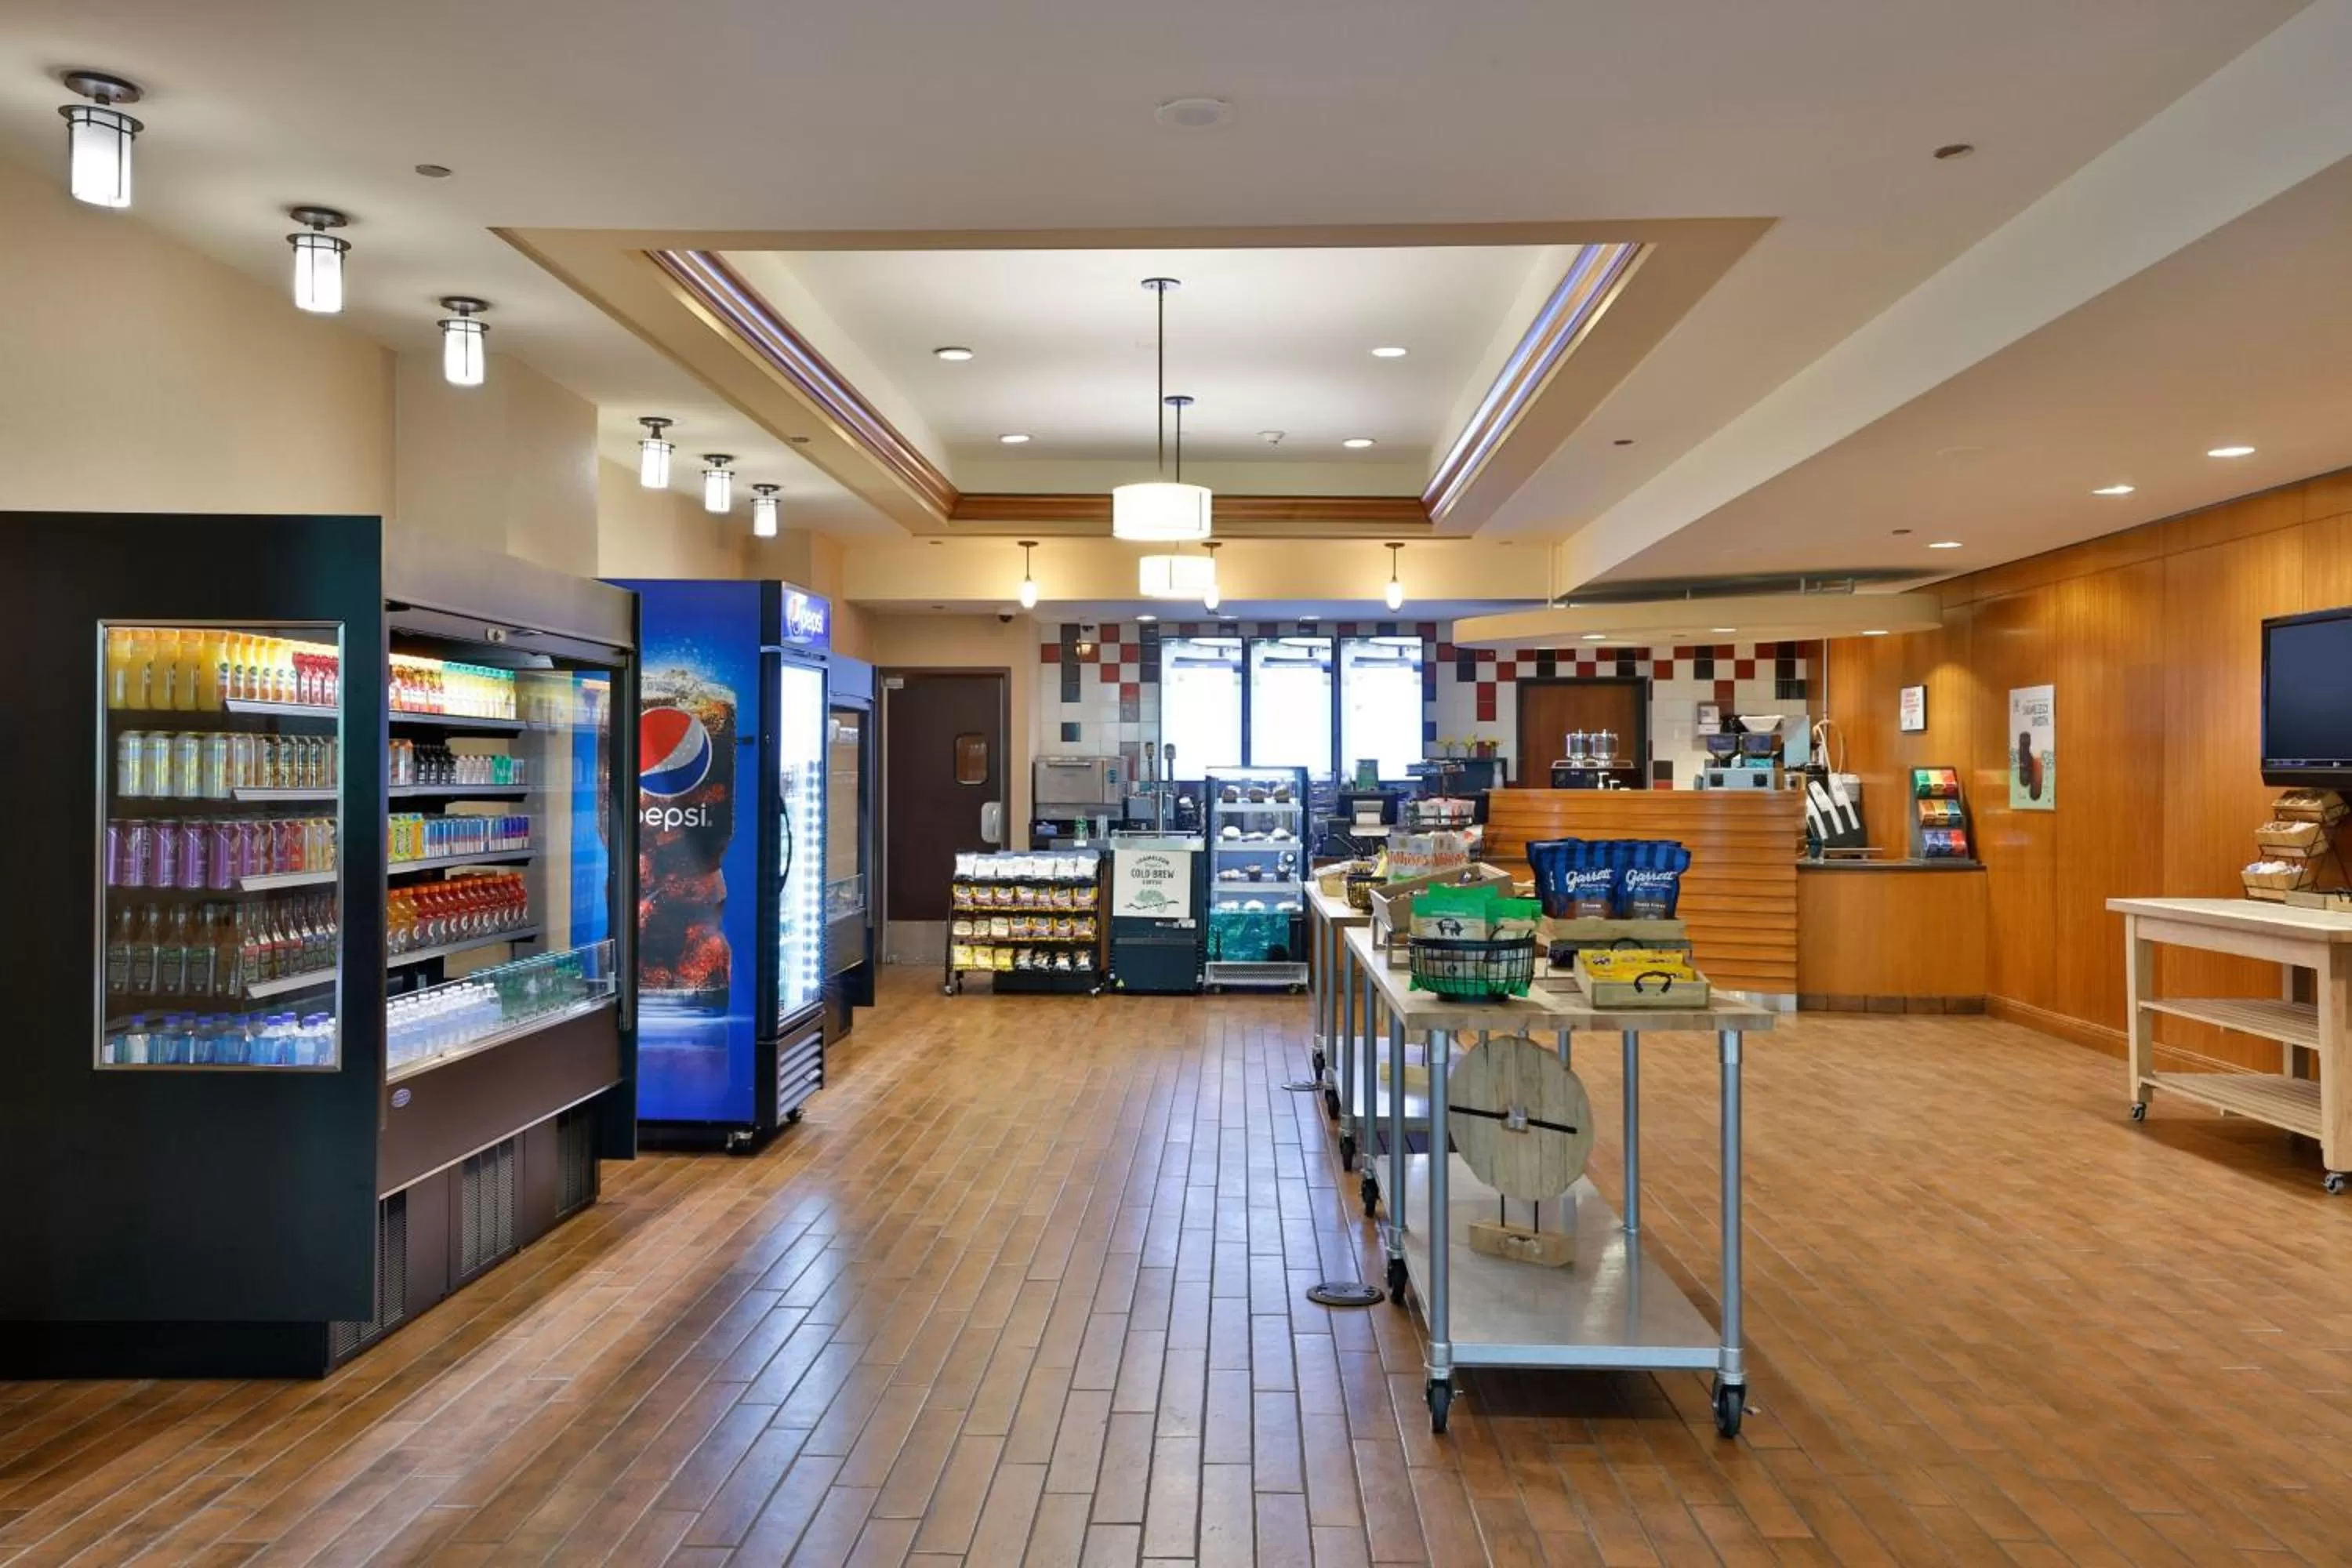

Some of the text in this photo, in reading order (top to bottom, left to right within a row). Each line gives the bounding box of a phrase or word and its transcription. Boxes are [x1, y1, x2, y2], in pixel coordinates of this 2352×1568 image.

[640, 802, 706, 832] epsi
[1131, 867, 1176, 879] COLD BREW
